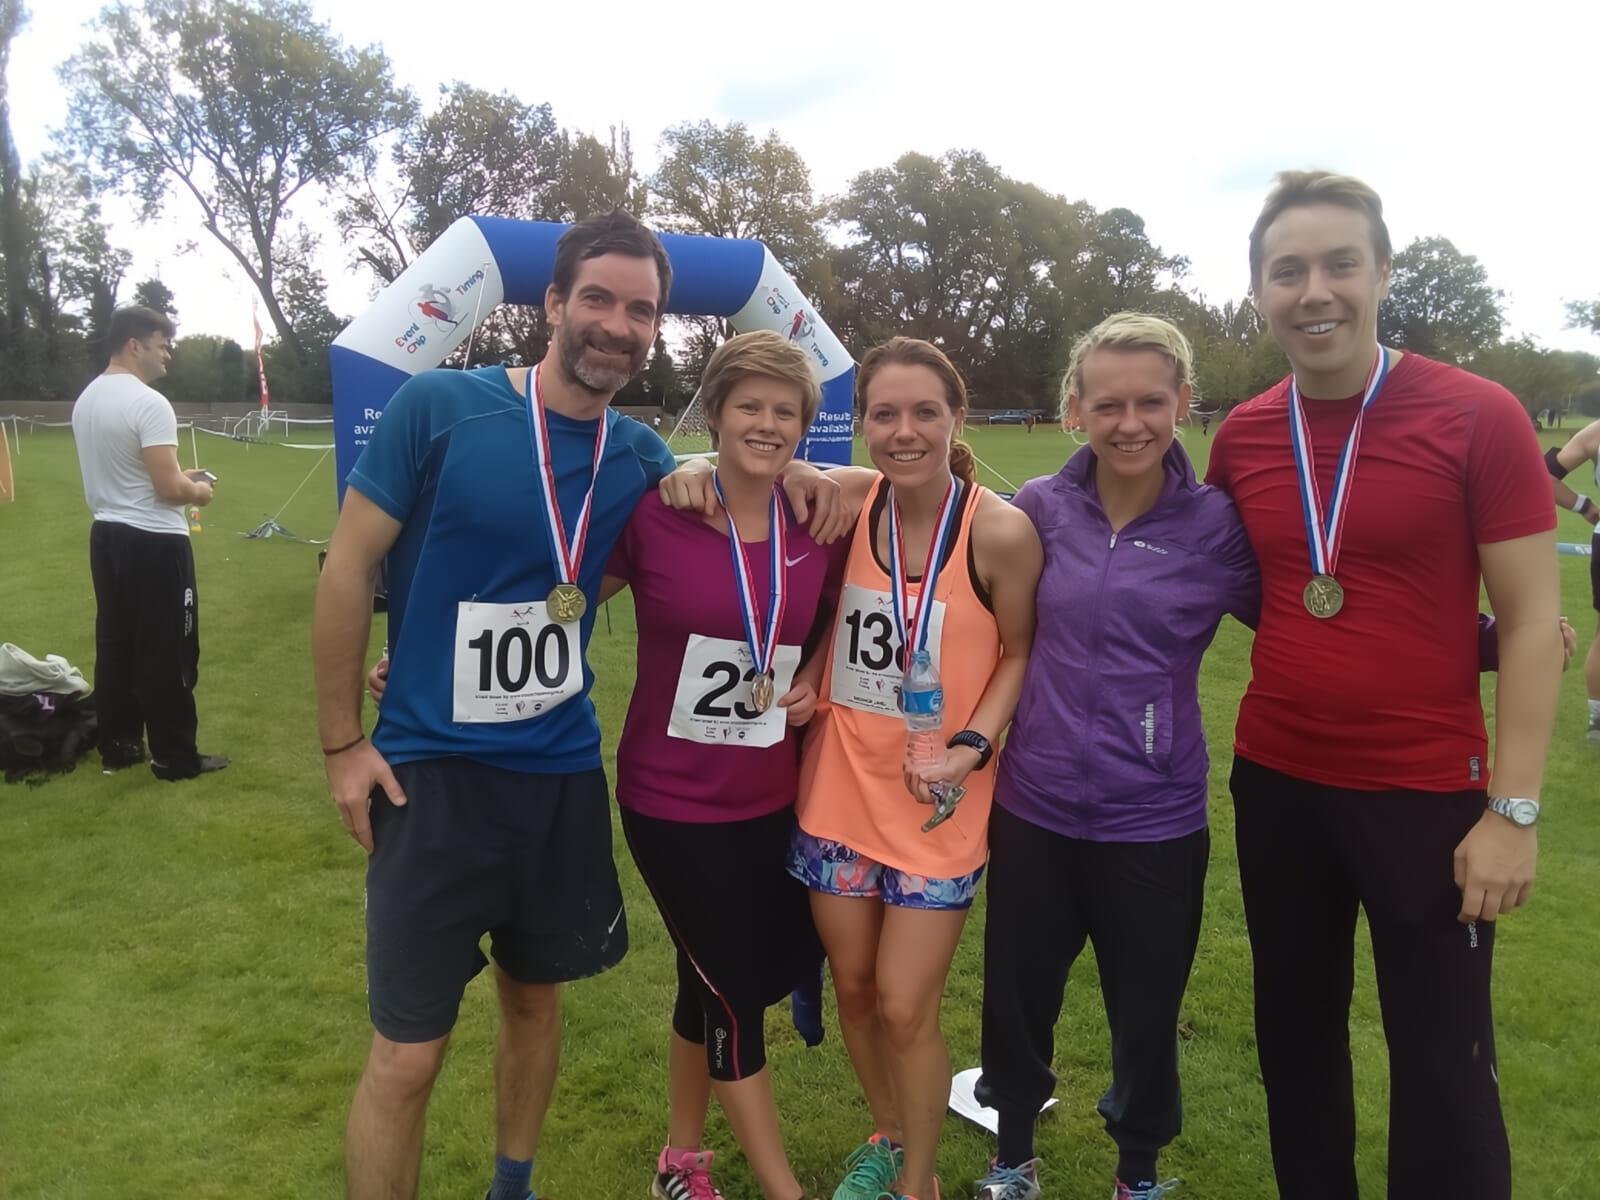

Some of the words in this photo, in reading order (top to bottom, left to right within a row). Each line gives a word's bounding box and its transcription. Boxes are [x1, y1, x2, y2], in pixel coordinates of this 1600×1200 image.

[456, 269, 485, 296] Timing
[395, 322, 421, 348] Event
[810, 342, 829, 367] Timing
[468, 623, 569, 693] 100
[1142, 703, 1154, 754] IRONMAN
